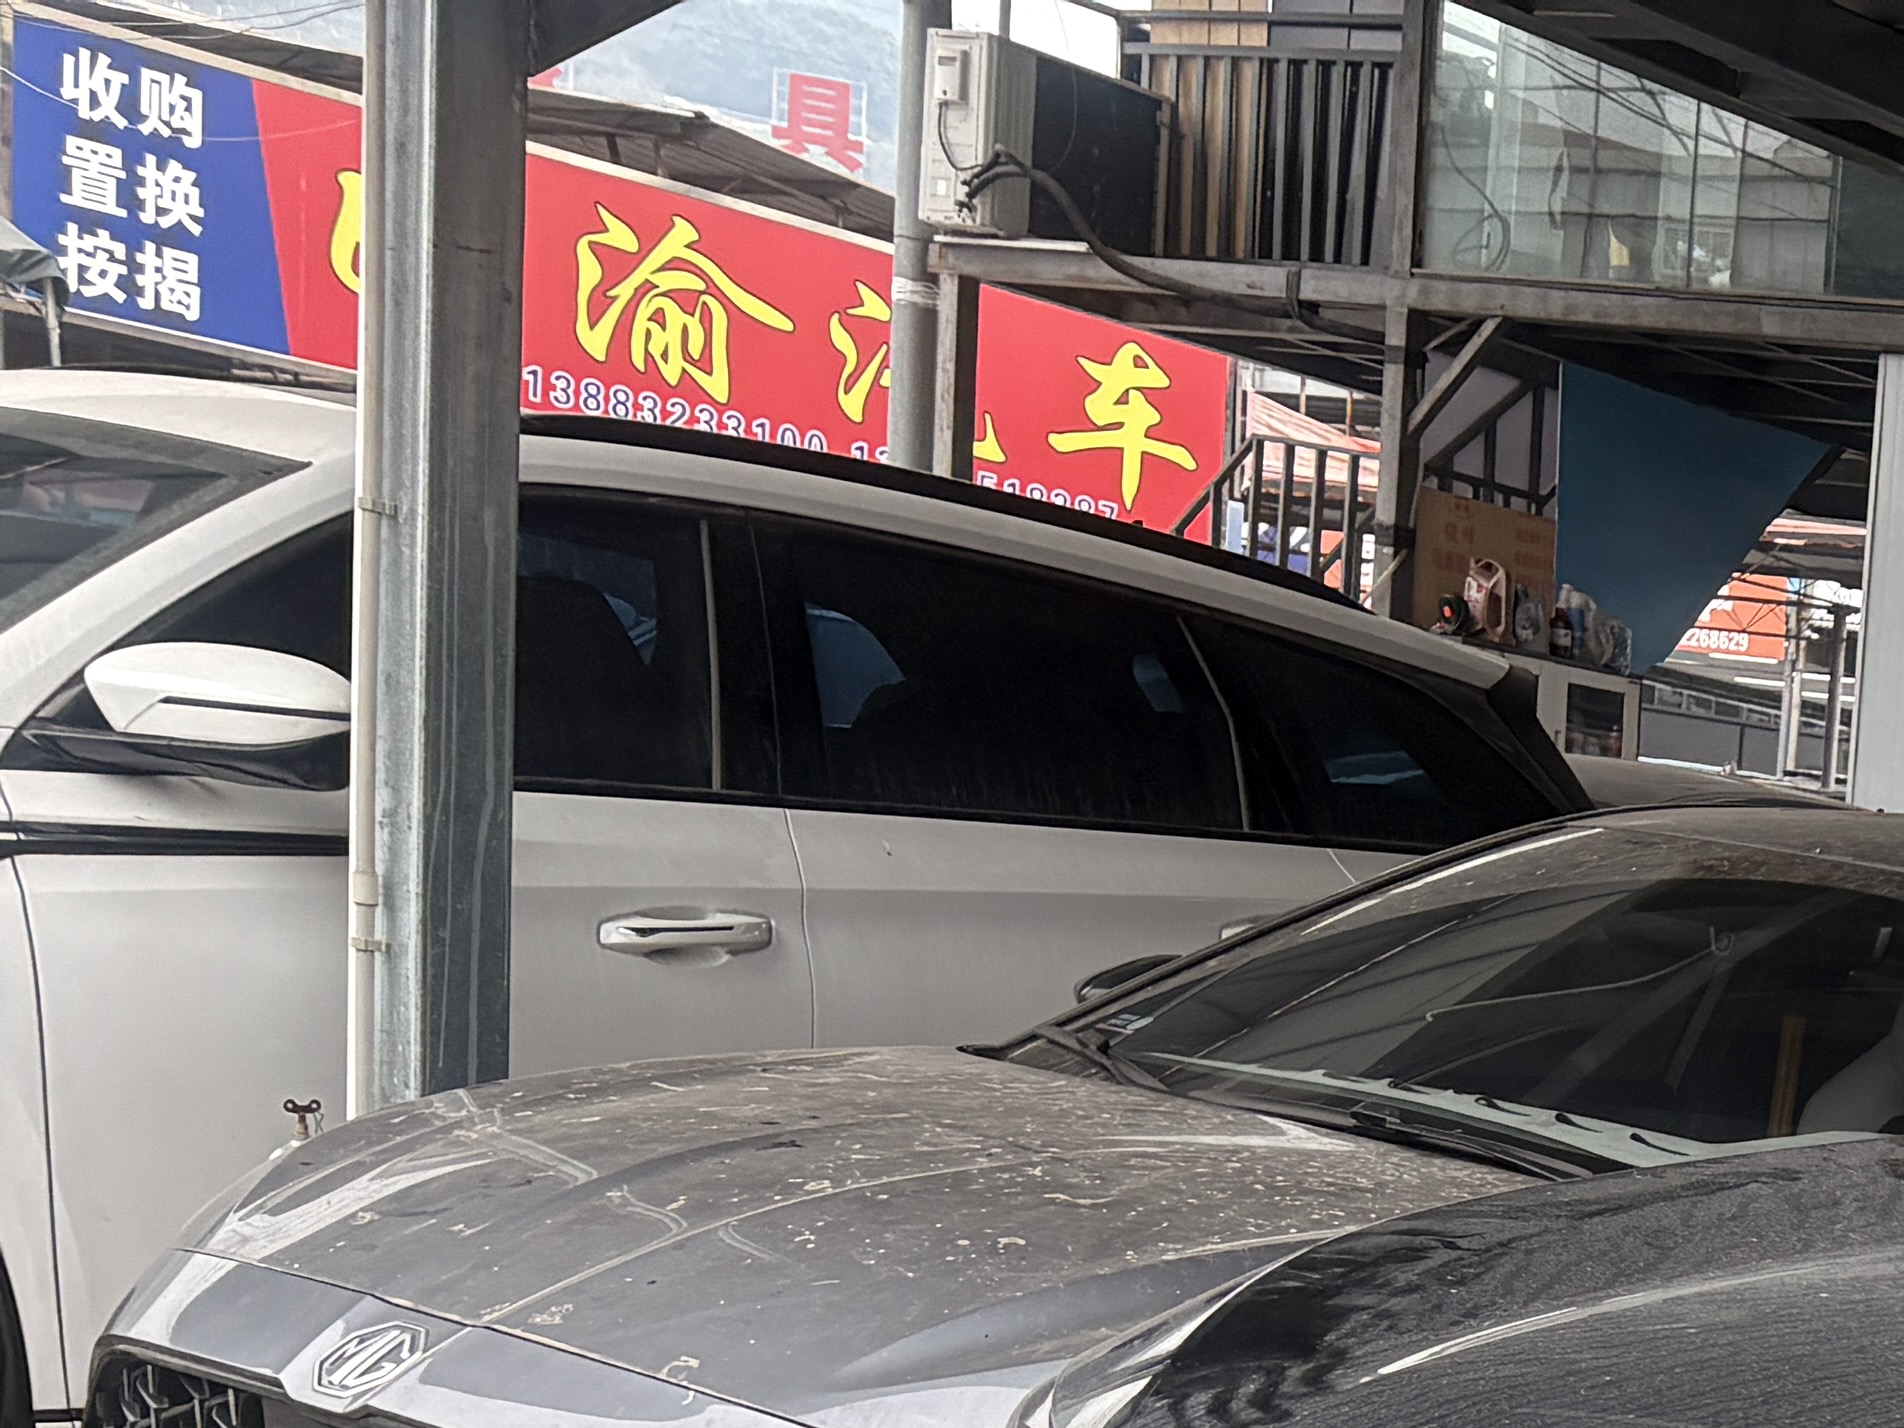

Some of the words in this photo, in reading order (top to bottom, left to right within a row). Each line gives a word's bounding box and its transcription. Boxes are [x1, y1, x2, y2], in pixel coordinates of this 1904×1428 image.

[59, 47, 203, 149] 收购
[771, 73, 864, 171] 具
[59, 135, 205, 236] 置换
[57, 222, 201, 322] 按揭
[330, 168, 1197, 512] 渝车
[322, 1328, 414, 1390] MG
